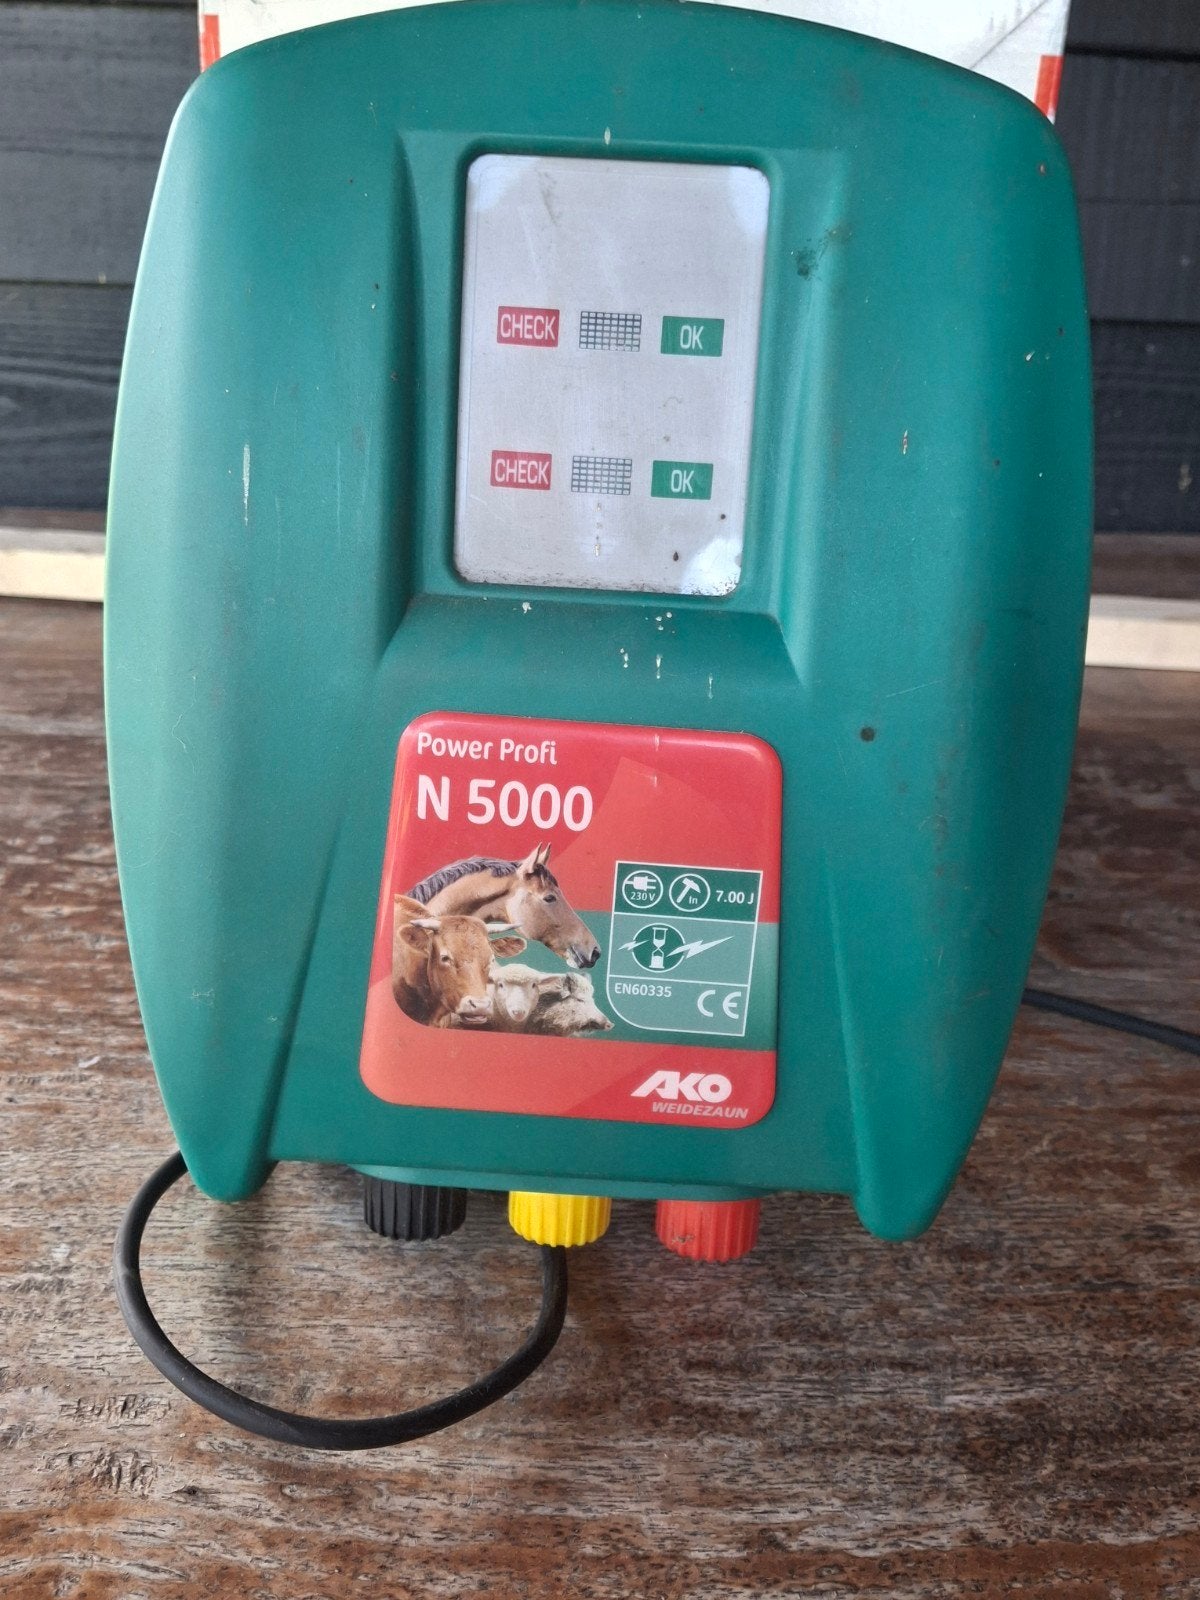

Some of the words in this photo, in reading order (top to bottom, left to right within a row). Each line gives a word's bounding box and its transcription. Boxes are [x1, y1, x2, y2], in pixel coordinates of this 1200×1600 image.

[500, 313, 556, 340] CHECK
[679, 325, 704, 350] OK
[494, 458, 549, 485] CHECK
[670, 469, 694, 494] OK
[417, 732, 493, 760] Power
[500, 738, 557, 765] Profi
[417, 774, 450, 822] N
[467, 778, 593, 832] 5000
[630, 891, 648, 901] 230
[648, 892, 655, 901] V
[716, 890, 745, 904] 7.00
[747, 893, 754, 905] J
[614, 982, 672, 998] EN60335
[697, 989, 742, 1020] CE
[630, 1070, 732, 1103] AKO
[652, 1101, 749, 1119] WEIDEZAUN
